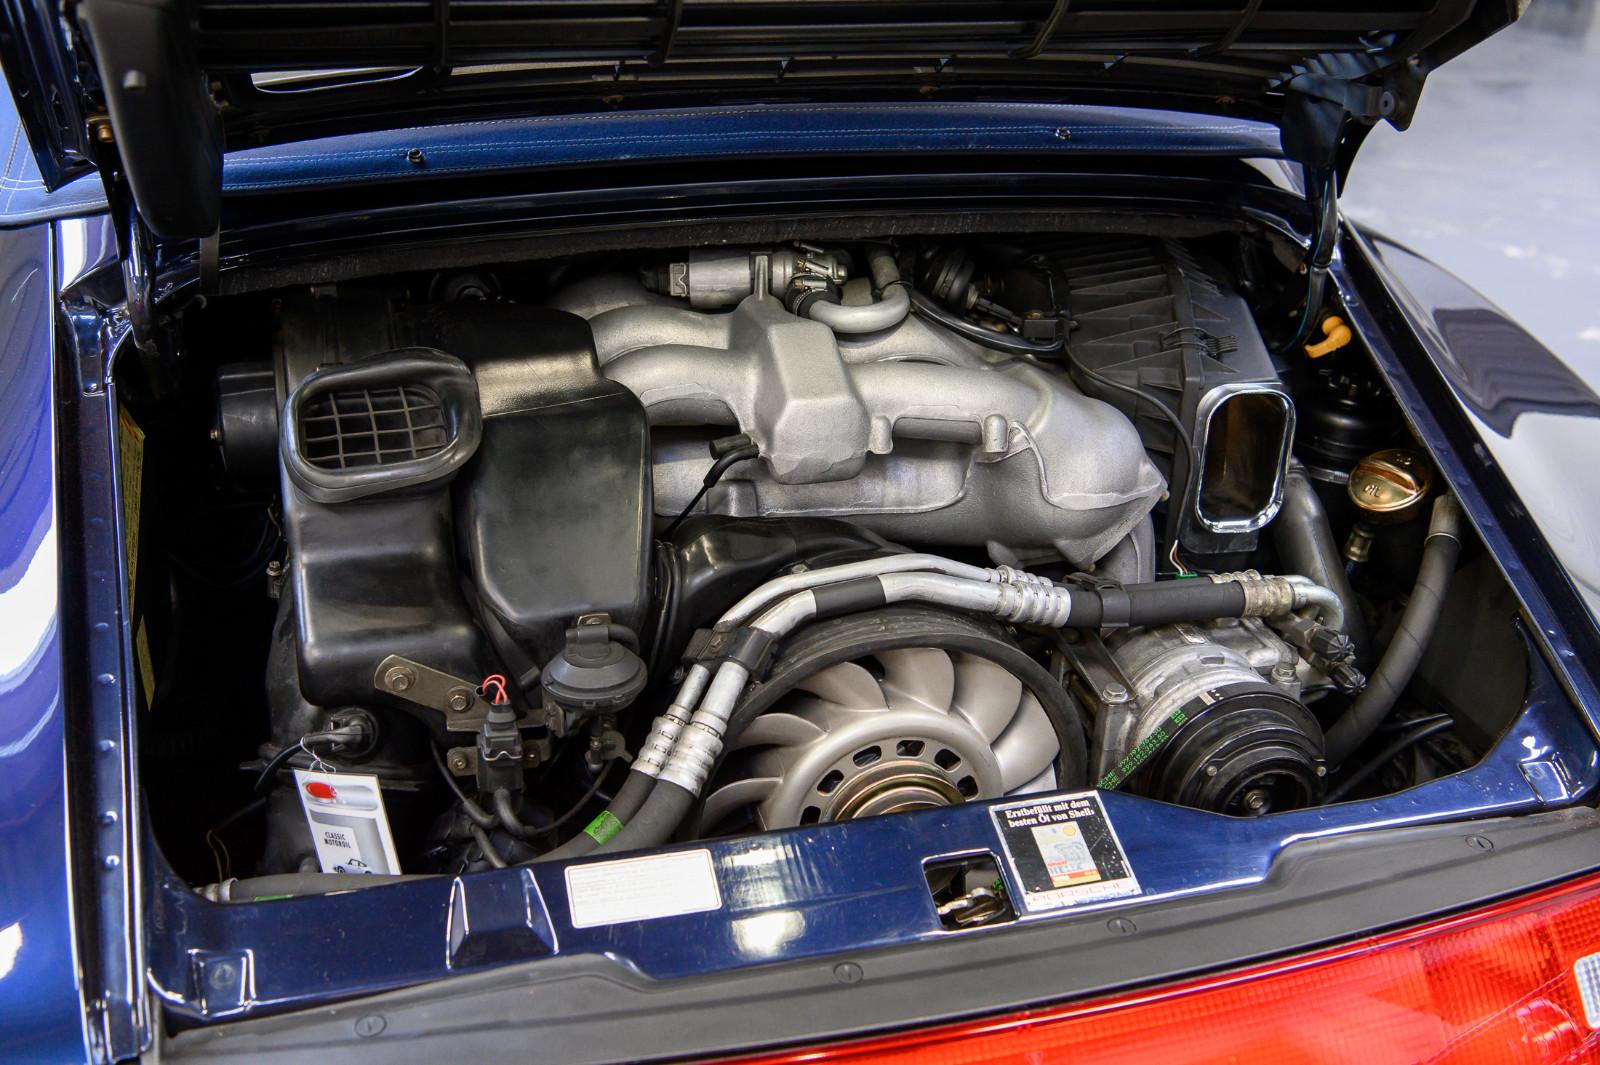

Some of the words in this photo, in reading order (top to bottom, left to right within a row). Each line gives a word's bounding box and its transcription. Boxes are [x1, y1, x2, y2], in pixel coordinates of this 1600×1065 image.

[1053, 803, 1069, 813] mit
[1071, 799, 1090, 810] dem
[1008, 816, 1038, 828] besten
[1038, 813, 1051, 824] Öl
[1051, 813, 1069, 822] von
[324, 831, 346, 841] CLASSIC
